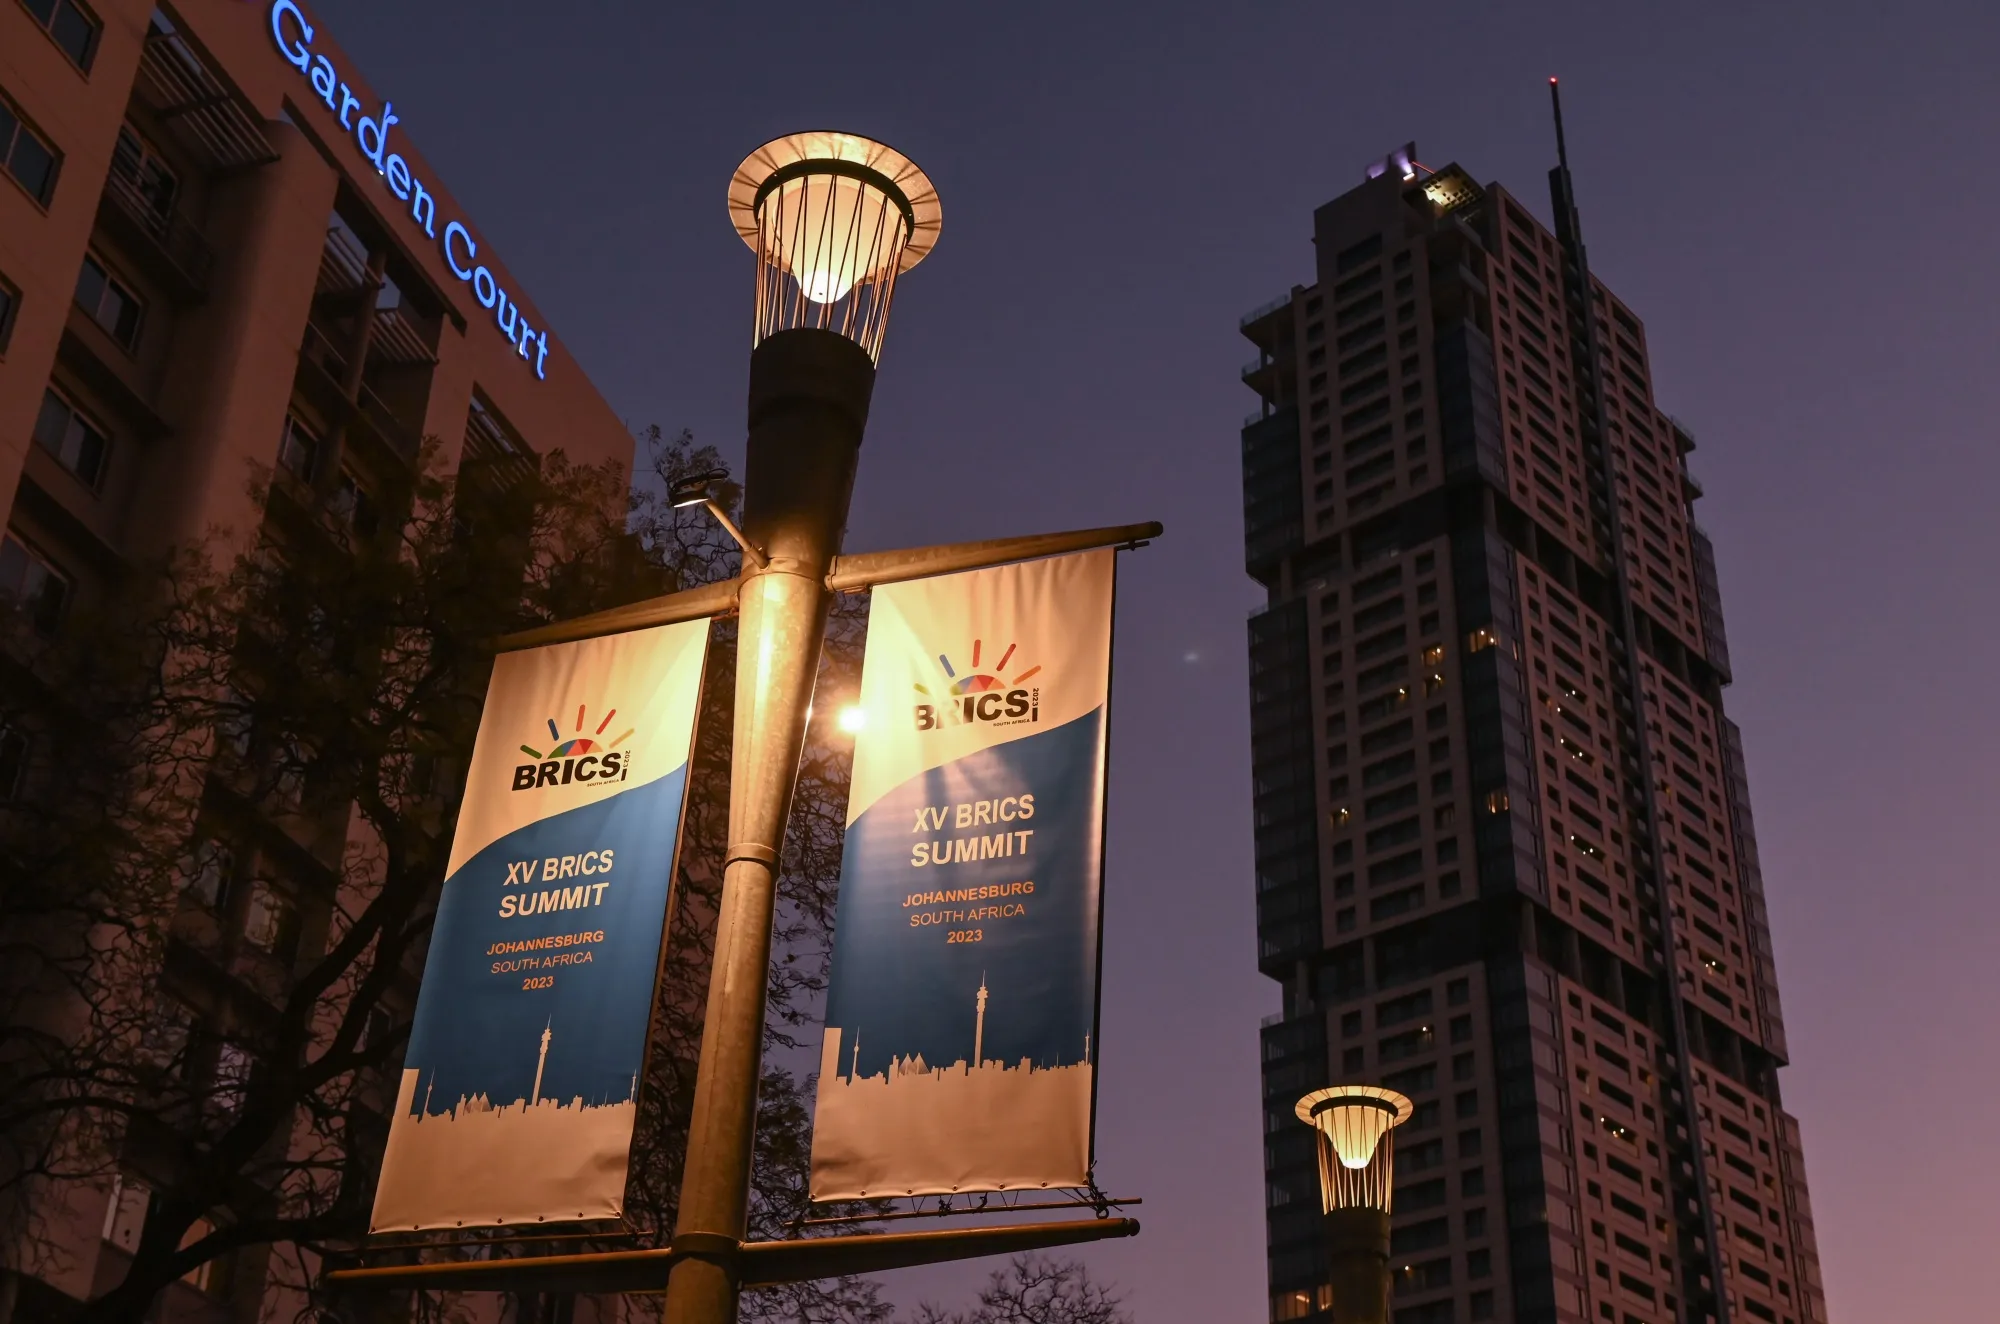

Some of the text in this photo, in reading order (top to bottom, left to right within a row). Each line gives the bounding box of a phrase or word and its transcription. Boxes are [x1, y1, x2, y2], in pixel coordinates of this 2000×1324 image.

[272, 0, 548, 379] Garden Court
[1032, 687, 1040, 707] 2023
[512, 752, 622, 791] BRICS
[623, 749, 631, 768] 2023
[912, 793, 1035, 833] XV BRICS
[910, 829, 1034, 867] SUMMIT
[503, 849, 614, 886] XV BRICS
[498, 882, 610, 918] SUMMIT
[902, 881, 1035, 908] JOHANNESBURG
[909, 903, 1025, 927] SOUTH AFRICA
[486, 930, 604, 956] JOHANNESBURG
[946, 929, 983, 944] 2023
[490, 951, 593, 974] SOUTH AFRICA
[522, 975, 554, 990] 2023
